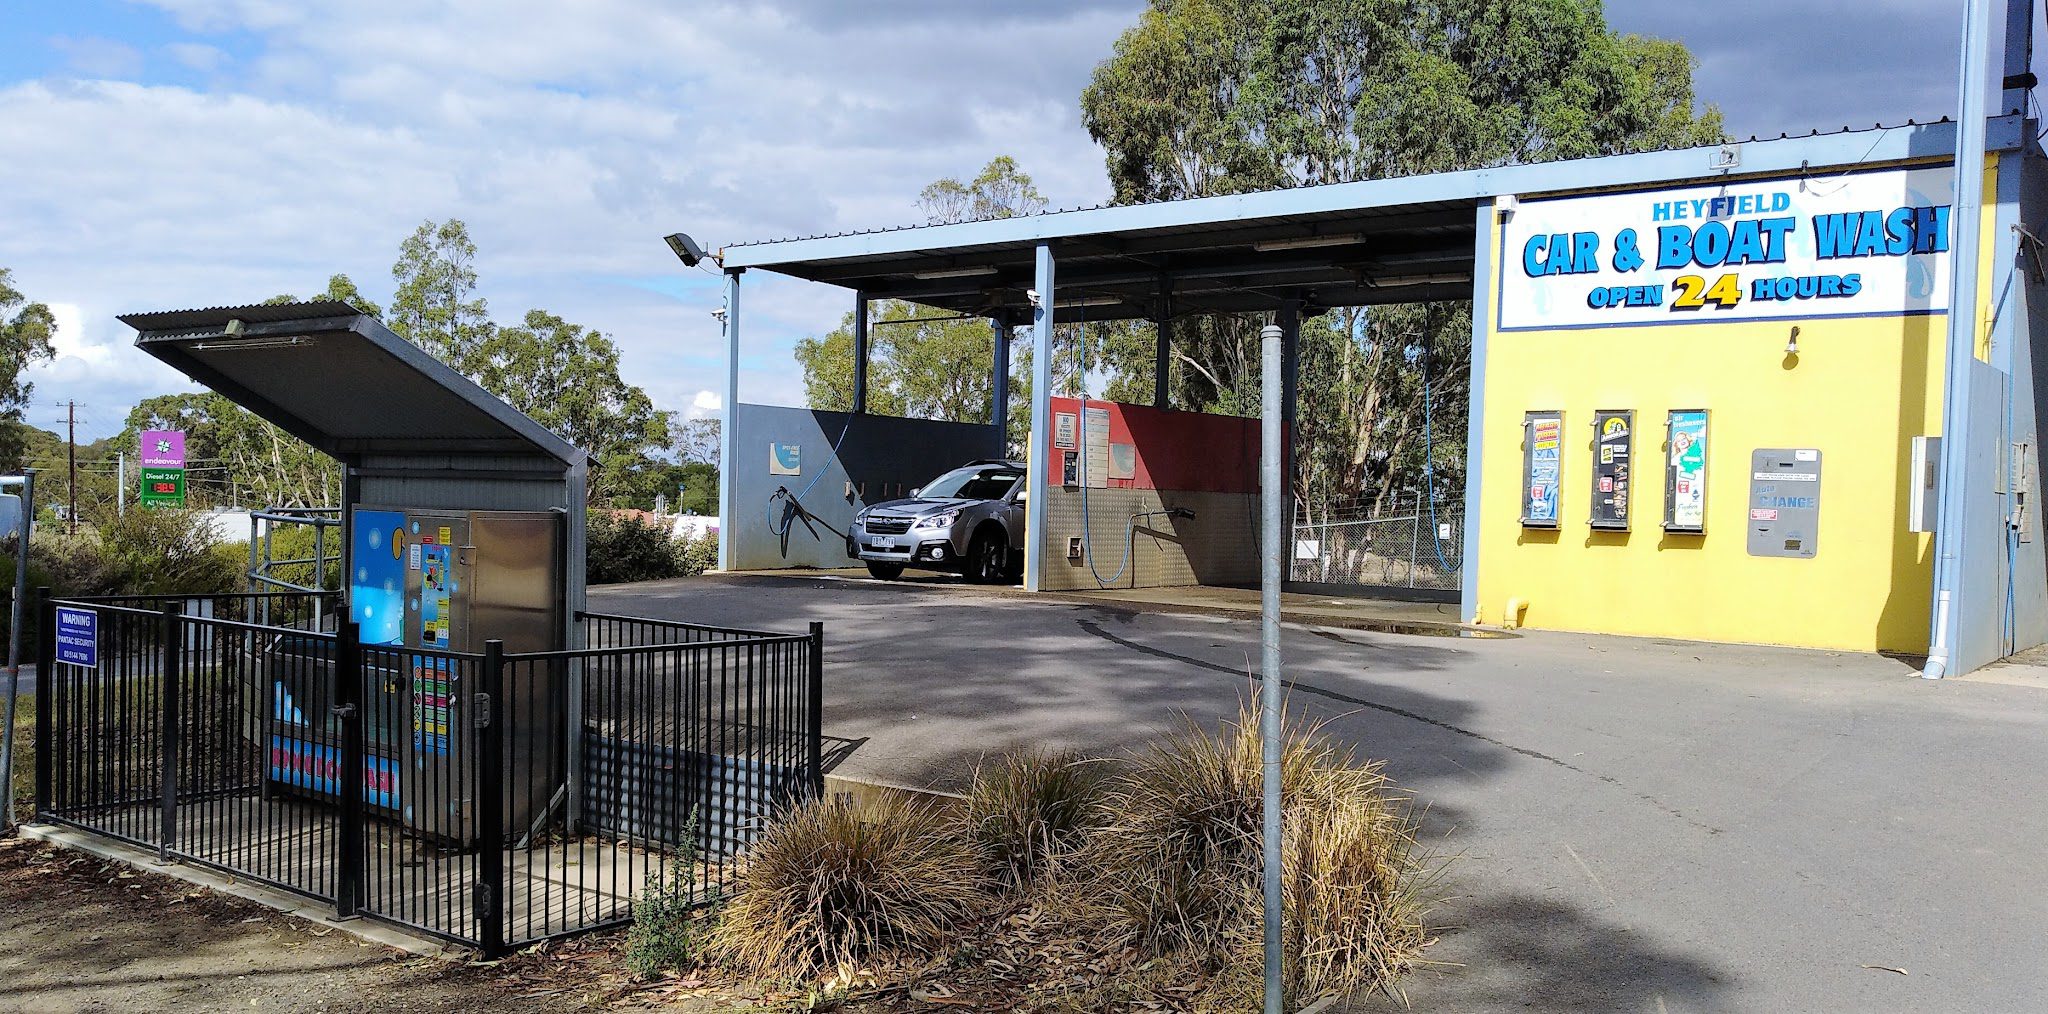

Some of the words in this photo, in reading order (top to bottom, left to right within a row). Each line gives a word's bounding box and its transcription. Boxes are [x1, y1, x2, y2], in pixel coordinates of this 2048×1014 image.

[1652, 193, 1790, 221] HEYFIELD
[1523, 232, 1600, 278] CAR
[1612, 228, 1644, 273] &
[1656, 217, 1795, 271] BOAT
[1812, 204, 1951, 261] WASH
[1587, 285, 1664, 309] OPEN
[1670, 273, 1742, 312] 24
[1750, 273, 1862, 302] HOURS
[144, 457, 182, 465] endeavour
[165, 473, 180, 481] 24/7
[62, 612, 91, 627] WARNING
[74, 637, 95, 648] SECURITY
